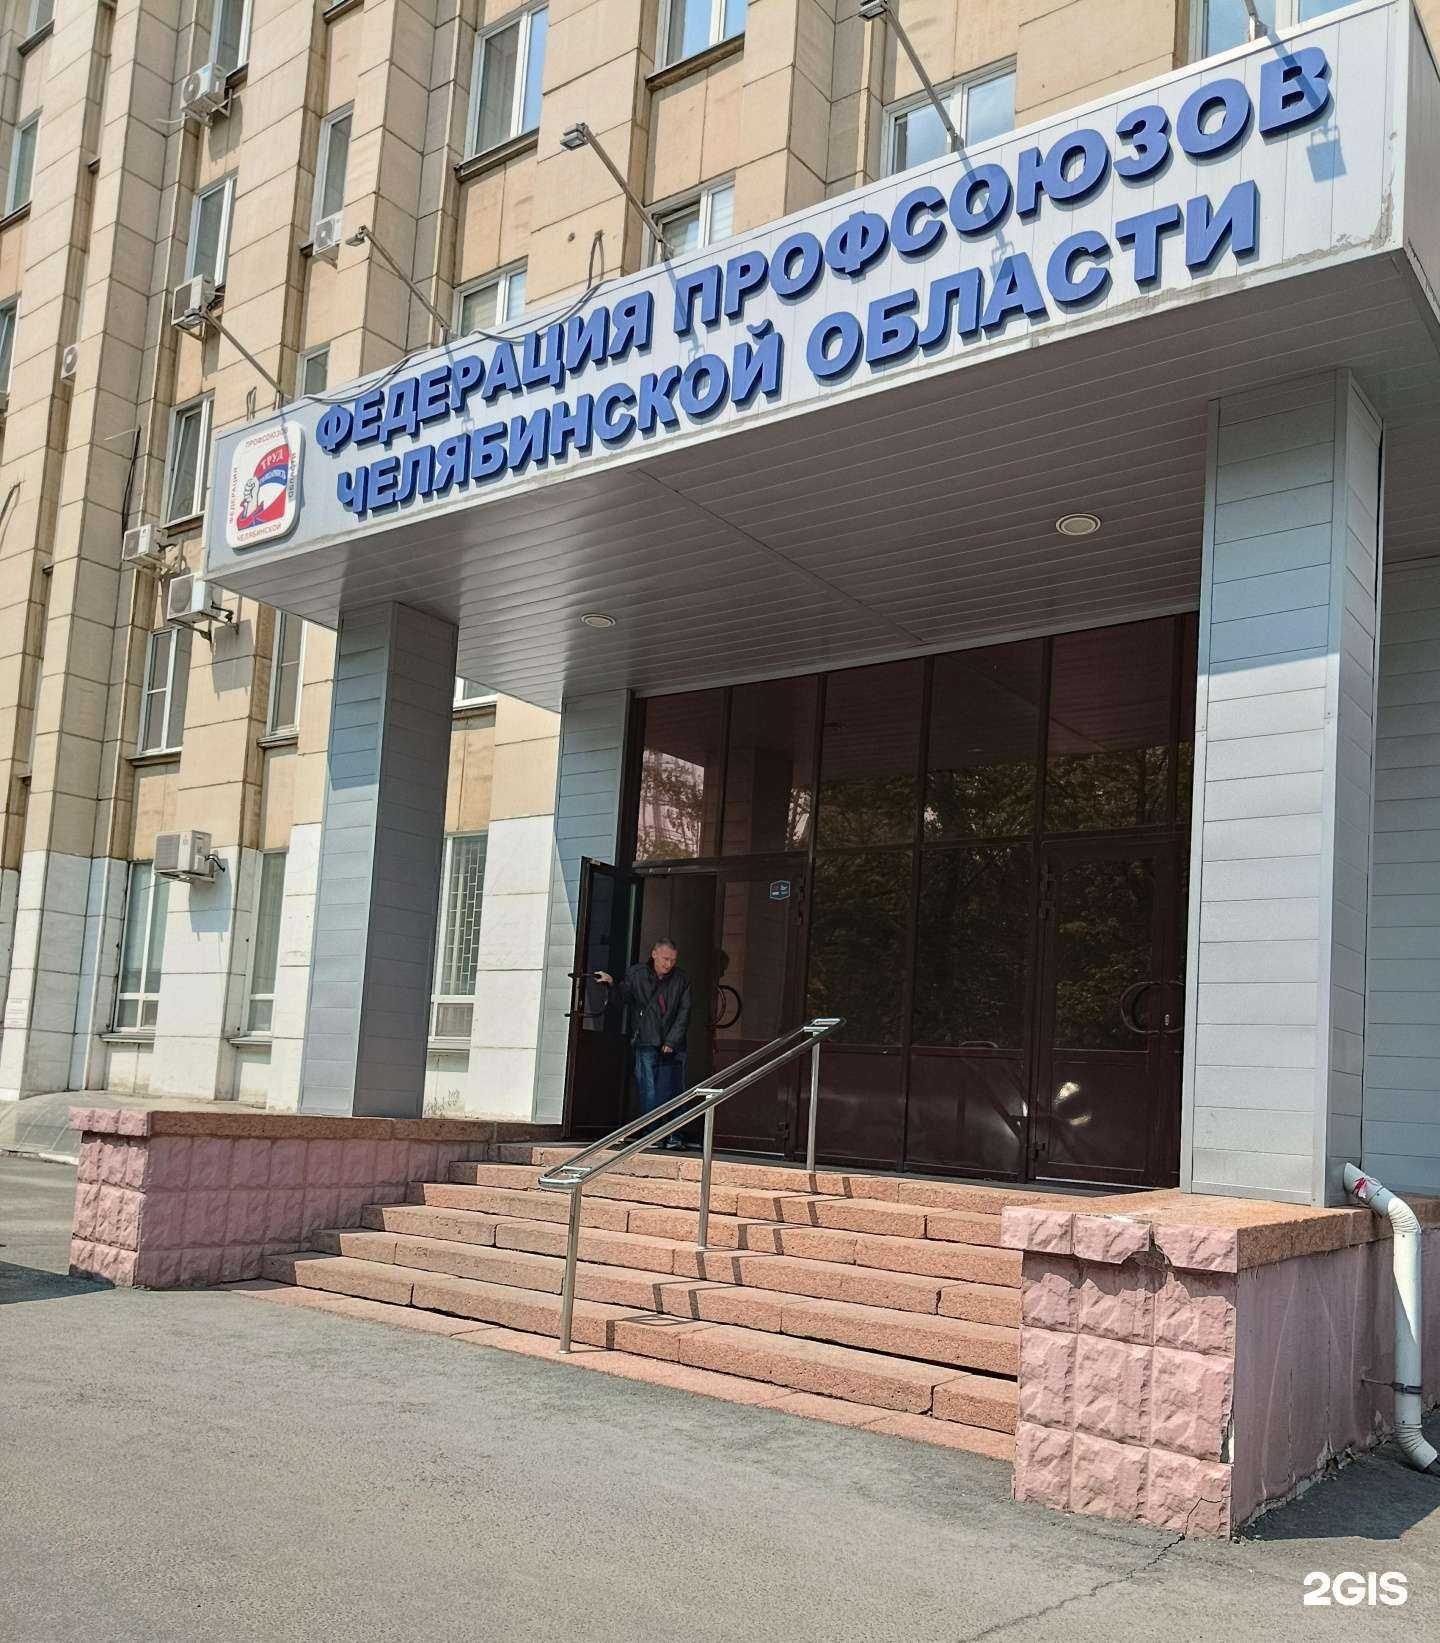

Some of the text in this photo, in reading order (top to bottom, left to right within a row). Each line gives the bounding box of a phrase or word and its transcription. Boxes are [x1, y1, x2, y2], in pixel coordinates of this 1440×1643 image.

[315, 46, 1332, 454] ФЕДЕРАЦИЯ ПРОФСОЮЗОВ
[336, 180, 1261, 518] ЧЕЛЯБИНСКОЙ ОБЛАСТИ
[260, 448, 285, 470] ТРУД
